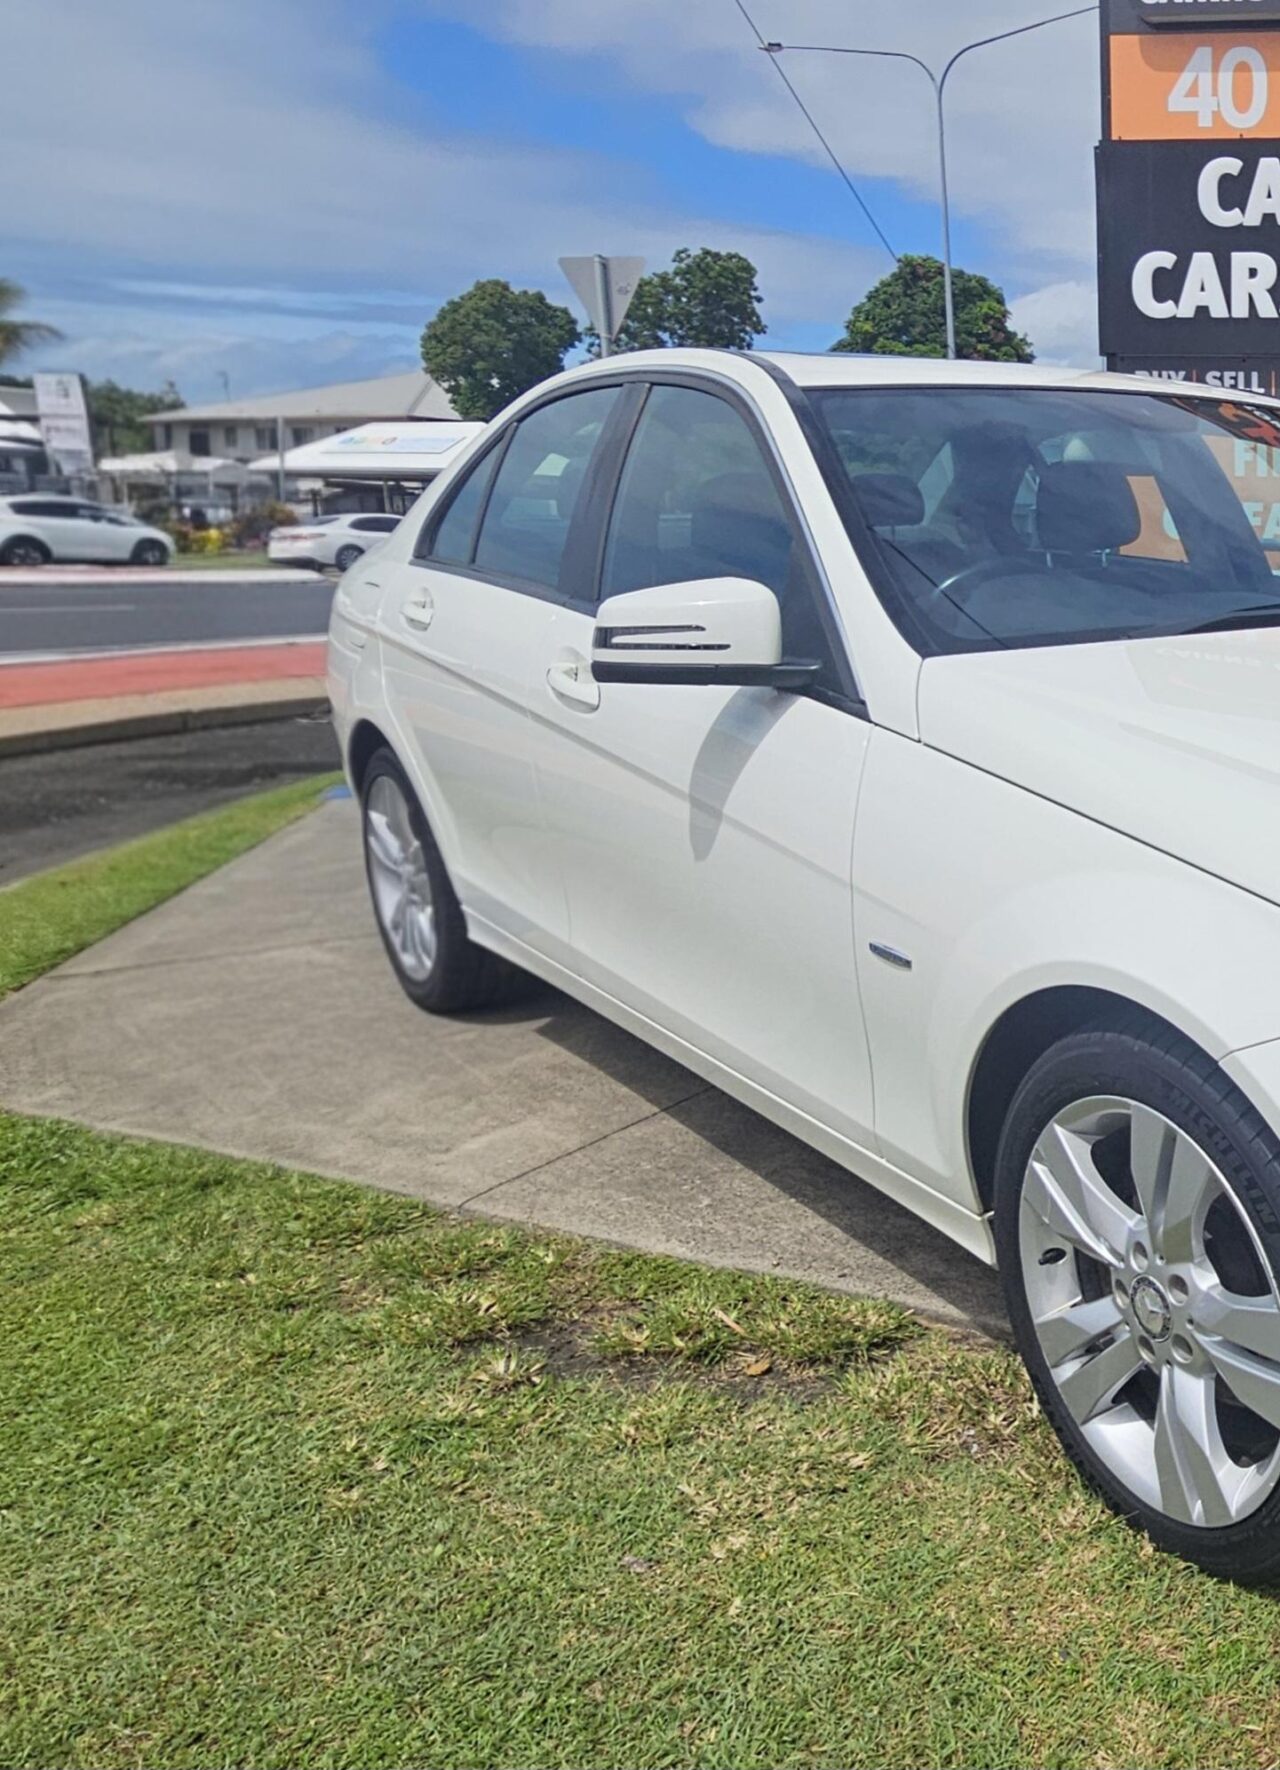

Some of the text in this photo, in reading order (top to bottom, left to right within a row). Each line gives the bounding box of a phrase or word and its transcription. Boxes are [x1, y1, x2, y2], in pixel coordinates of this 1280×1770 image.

[1167, 46, 1268, 128] 40
[1205, 371, 1266, 393] SELL
[1167, 1087, 1279, 1224] MICHELIN
